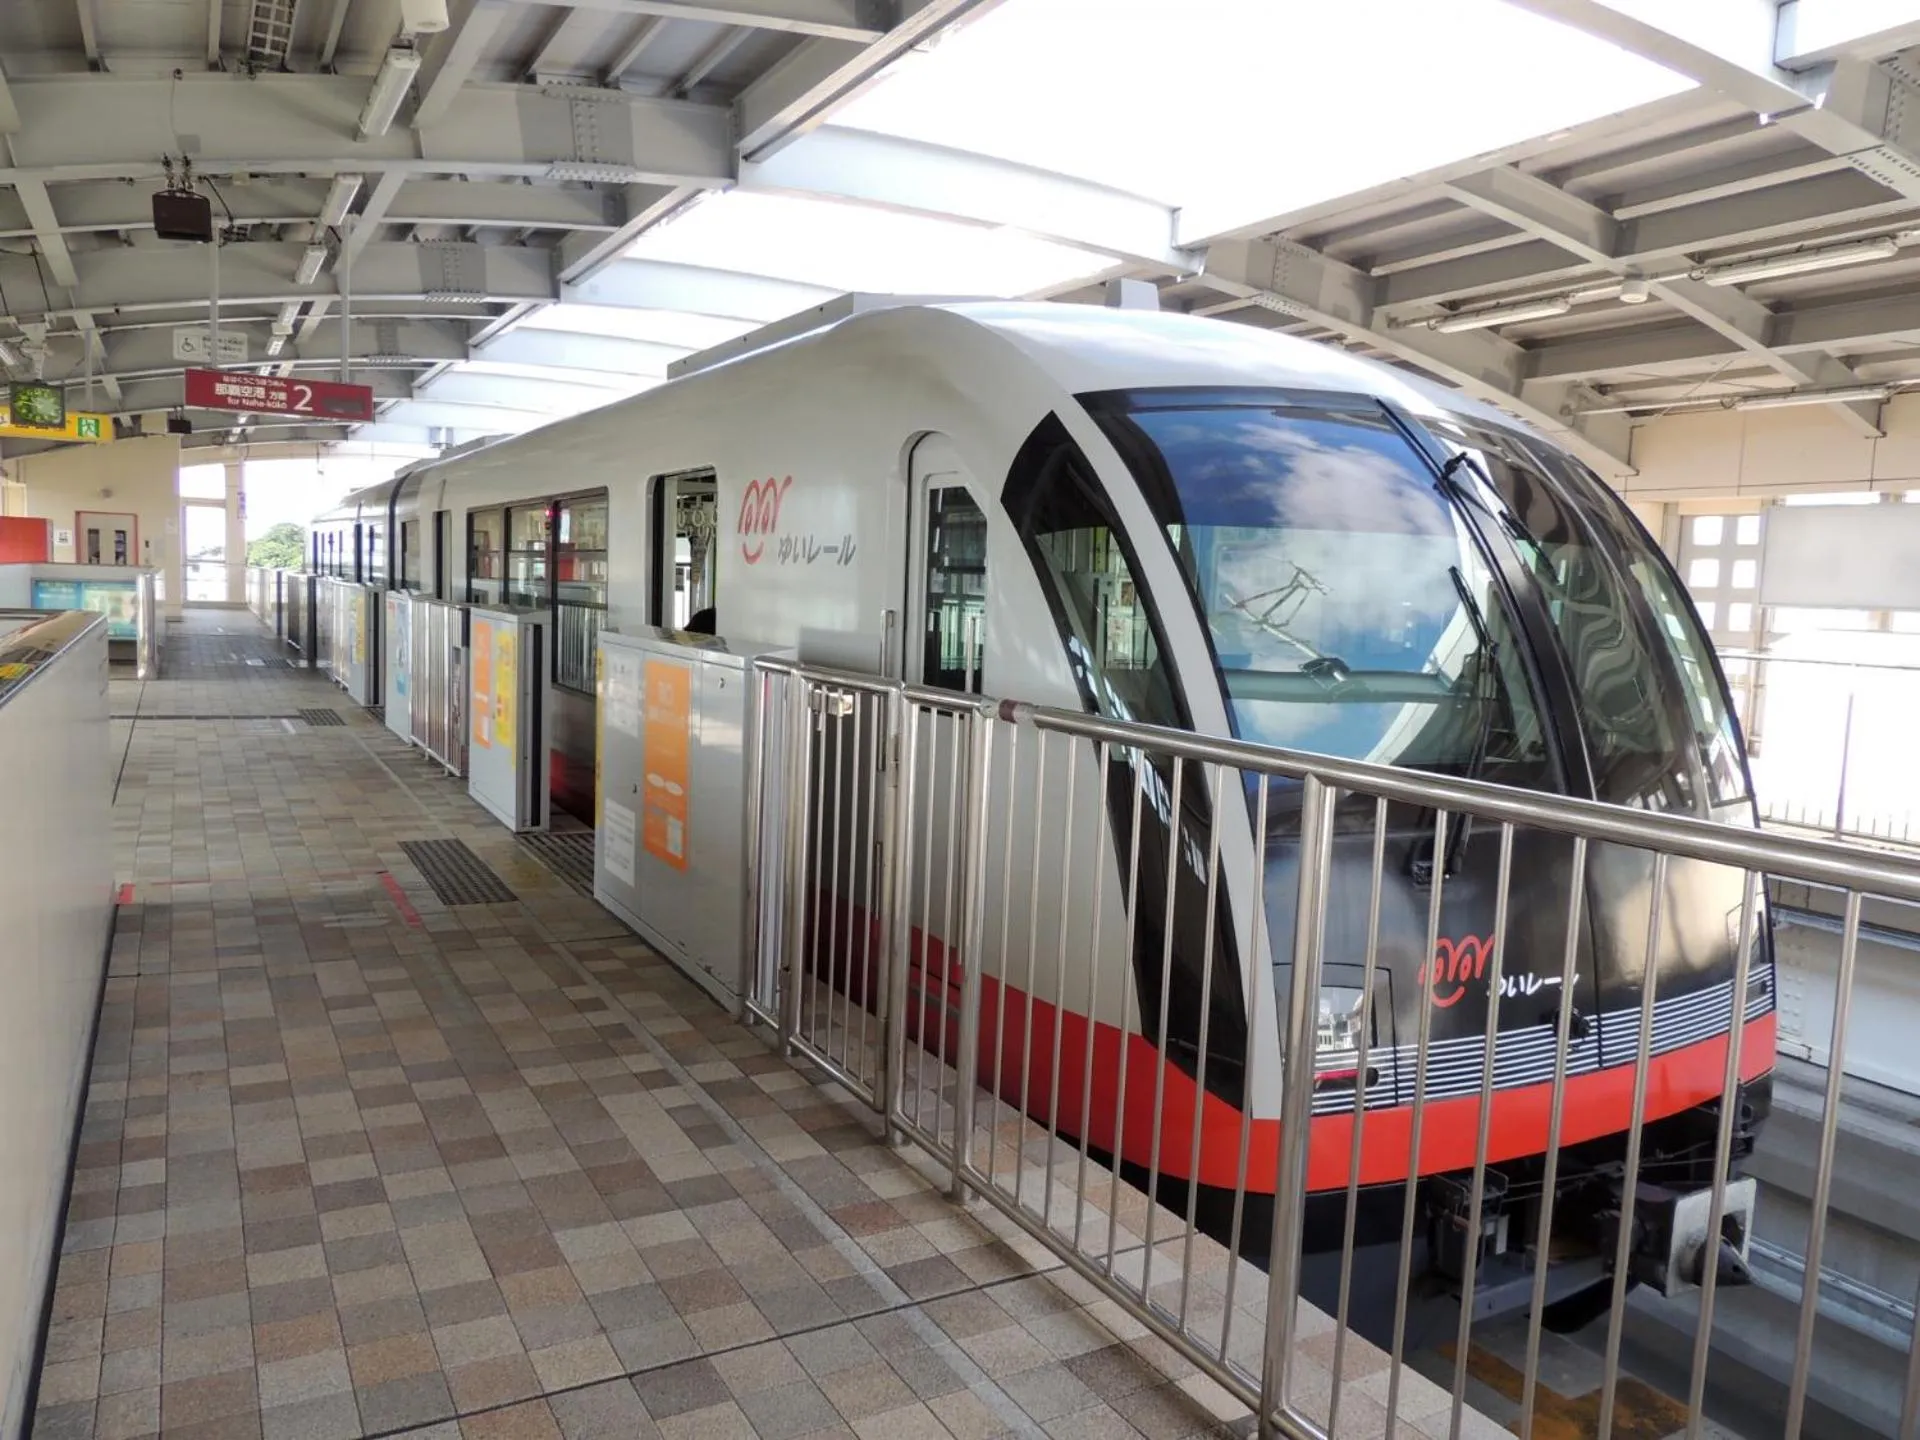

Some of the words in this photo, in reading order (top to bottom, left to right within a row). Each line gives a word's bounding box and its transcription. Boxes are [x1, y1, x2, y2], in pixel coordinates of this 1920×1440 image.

[293, 384, 313, 411] 2
[778, 533, 857, 566] ゆいレール
